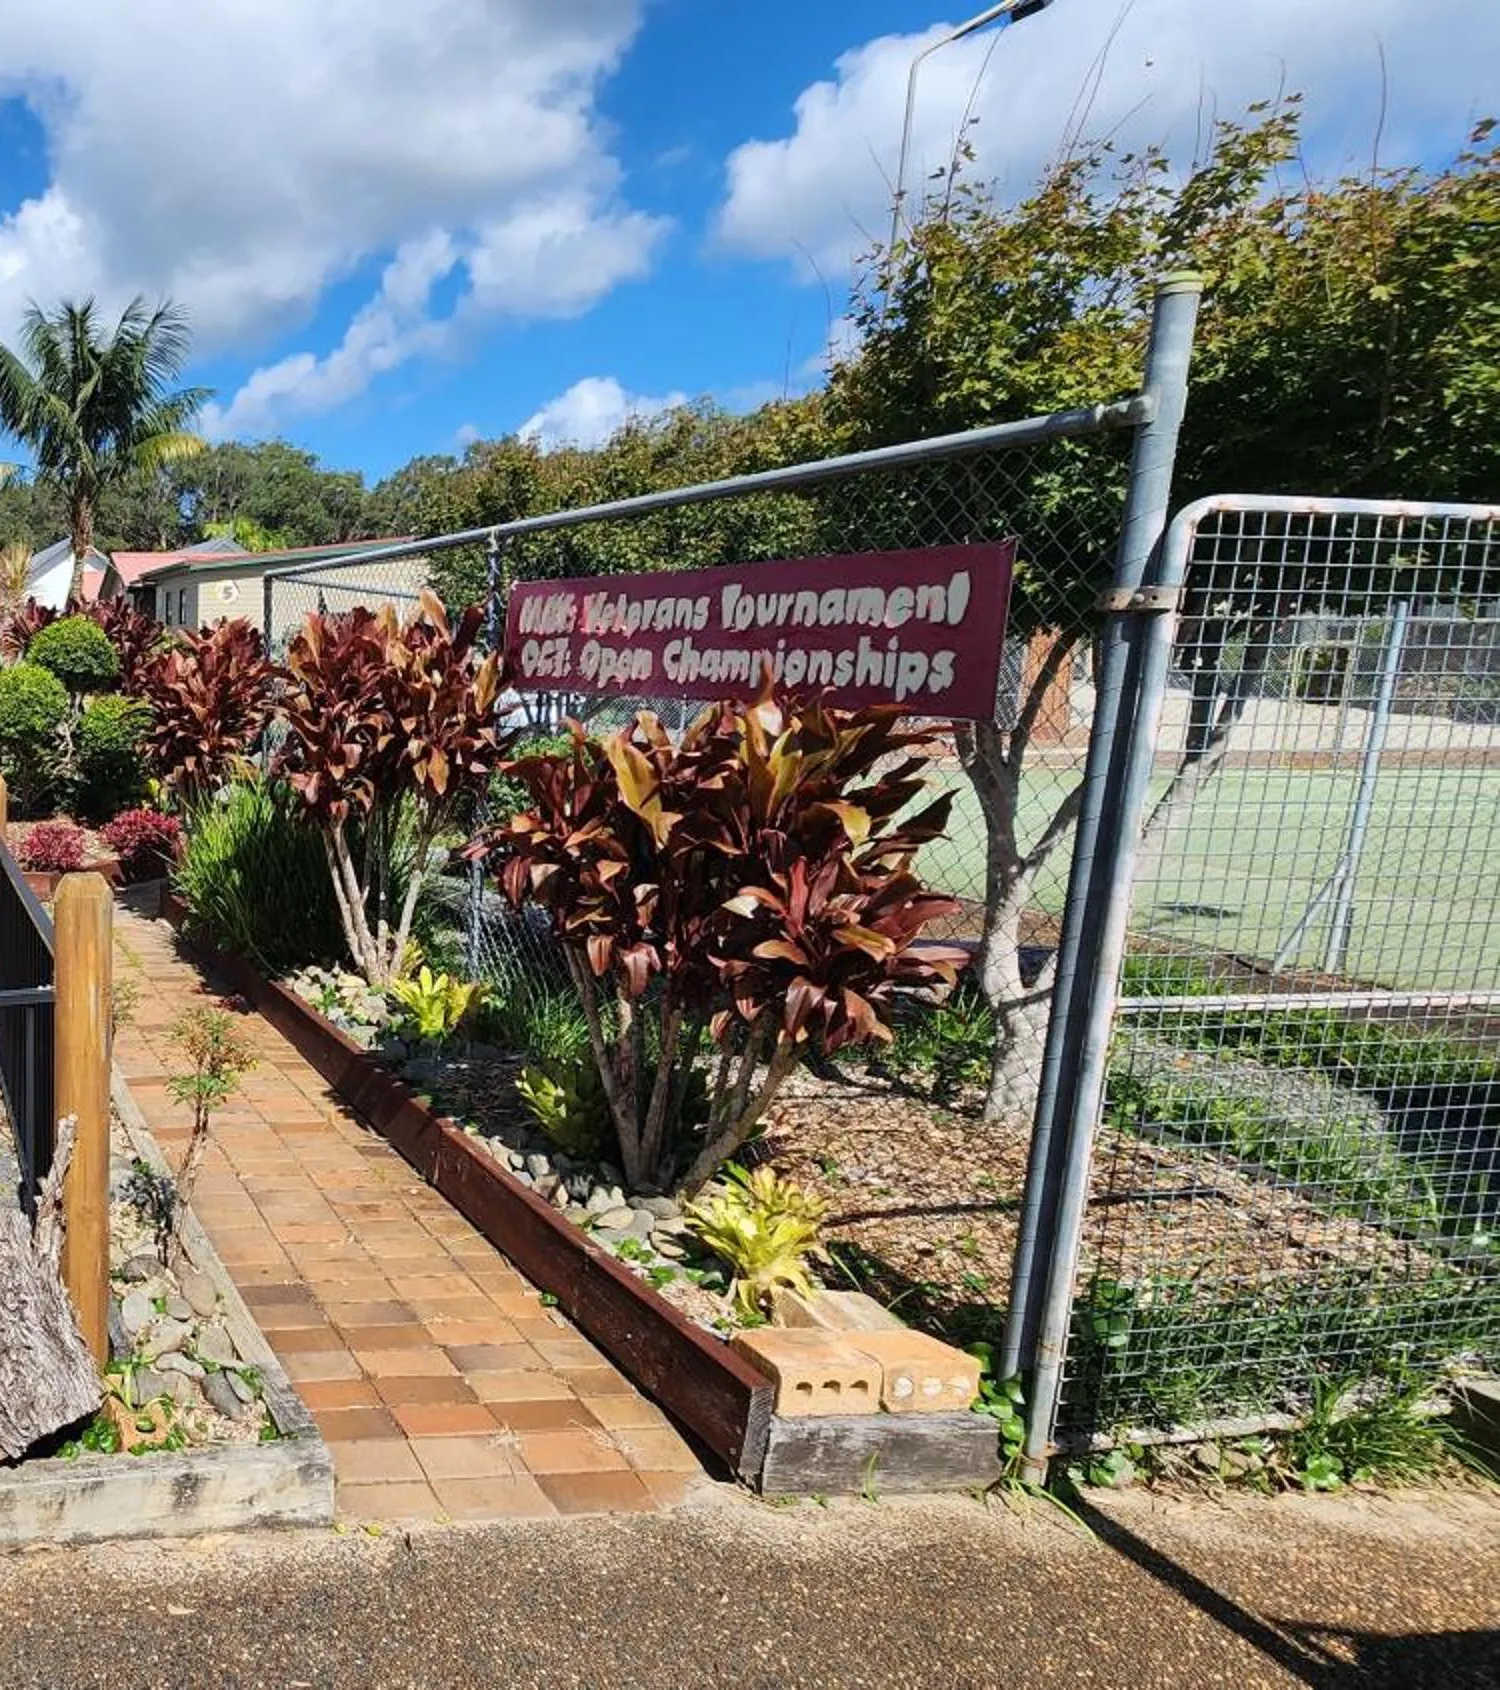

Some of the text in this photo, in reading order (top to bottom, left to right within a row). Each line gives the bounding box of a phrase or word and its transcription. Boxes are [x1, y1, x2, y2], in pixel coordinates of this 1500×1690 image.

[222, 585, 233, 600] 5
[581, 592, 711, 638] Veterans
[721, 571, 970, 631] Tournament
[580, 640, 652, 688] Open
